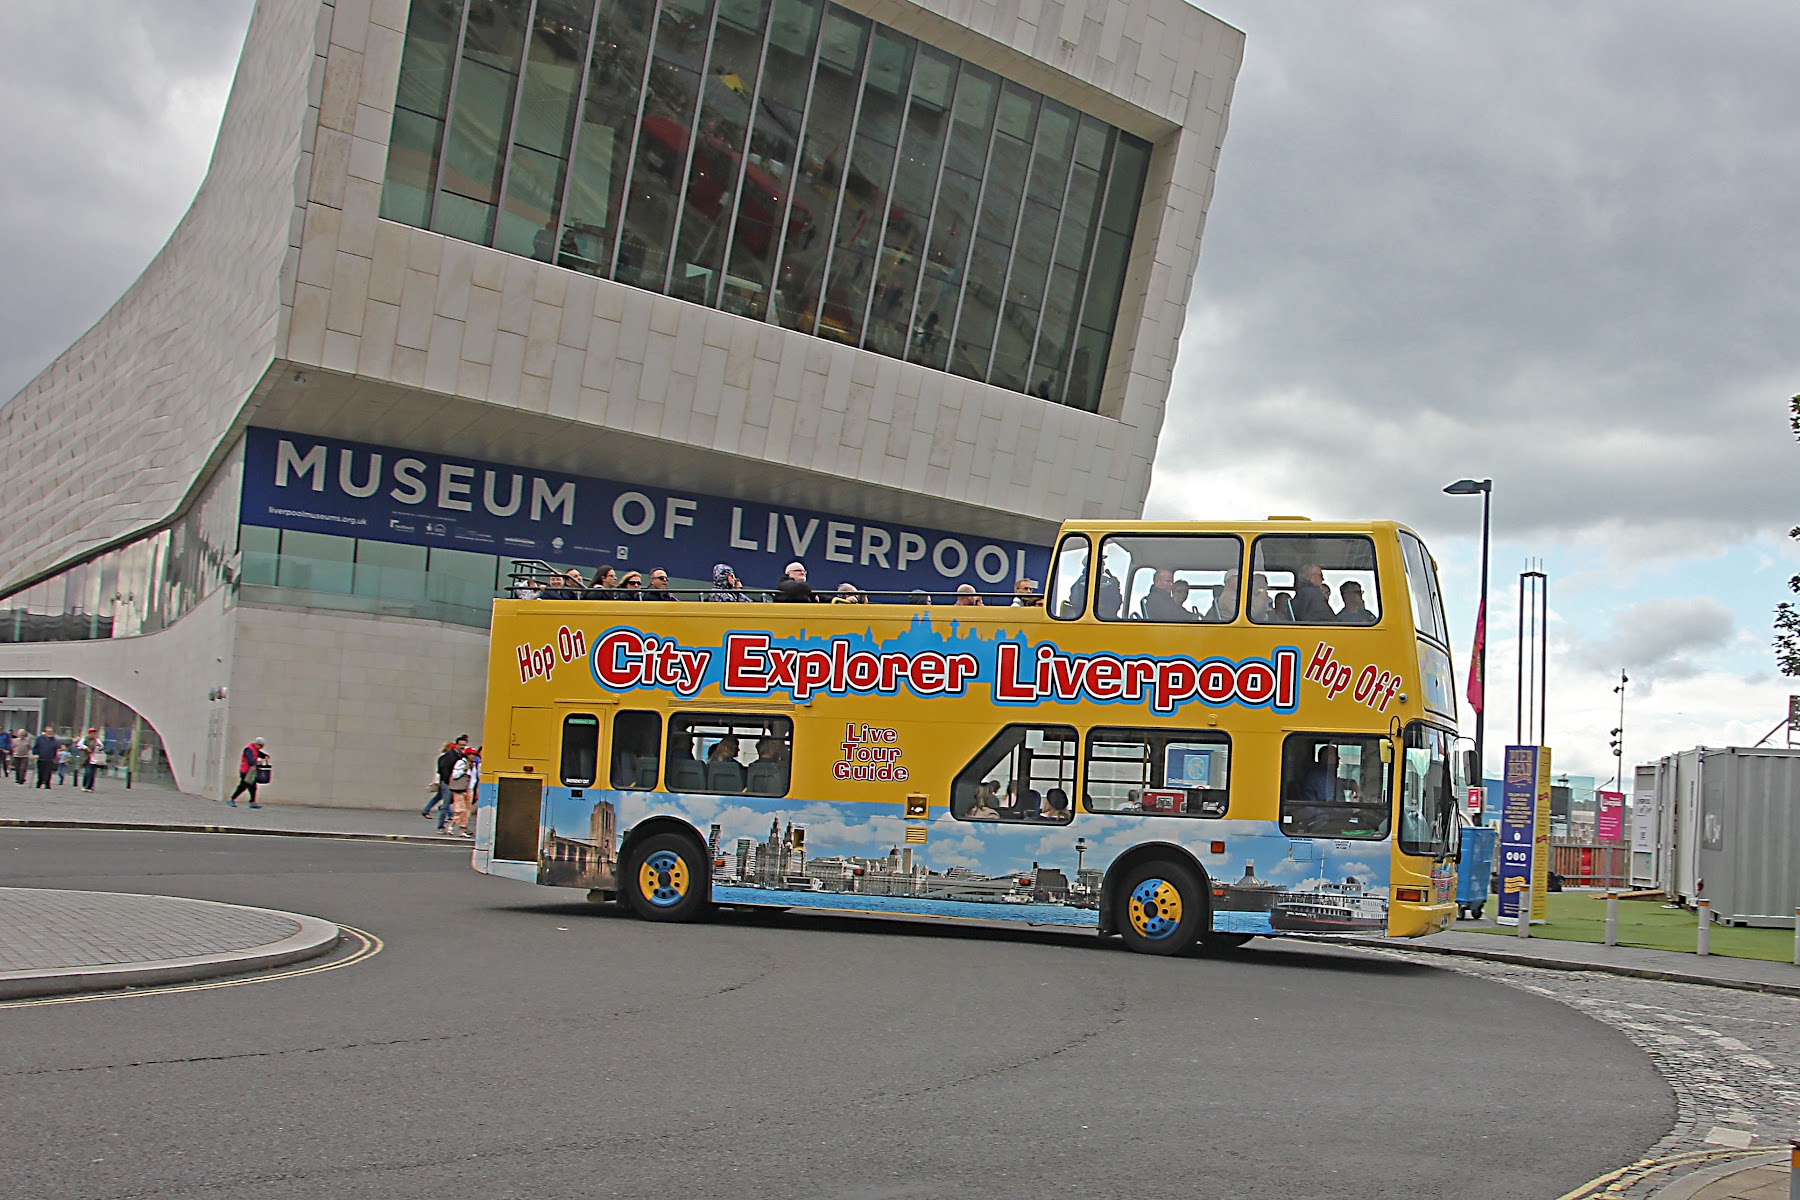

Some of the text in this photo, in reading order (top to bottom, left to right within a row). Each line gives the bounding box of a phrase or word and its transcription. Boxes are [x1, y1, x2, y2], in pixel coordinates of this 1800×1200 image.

[268, 506, 367, 525] liverpoolmuseums.org.uk
[274, 439, 1039, 589] MUSEUM OF LIVERPOOL
[516, 625, 587, 685] Hop On
[594, 630, 1298, 711] City Explorer Liverpool
[1304, 641, 1402, 713] Hop Off
[840, 742, 903, 763] Tour
[846, 723, 898, 745] Live
[832, 761, 909, 782] Guide
